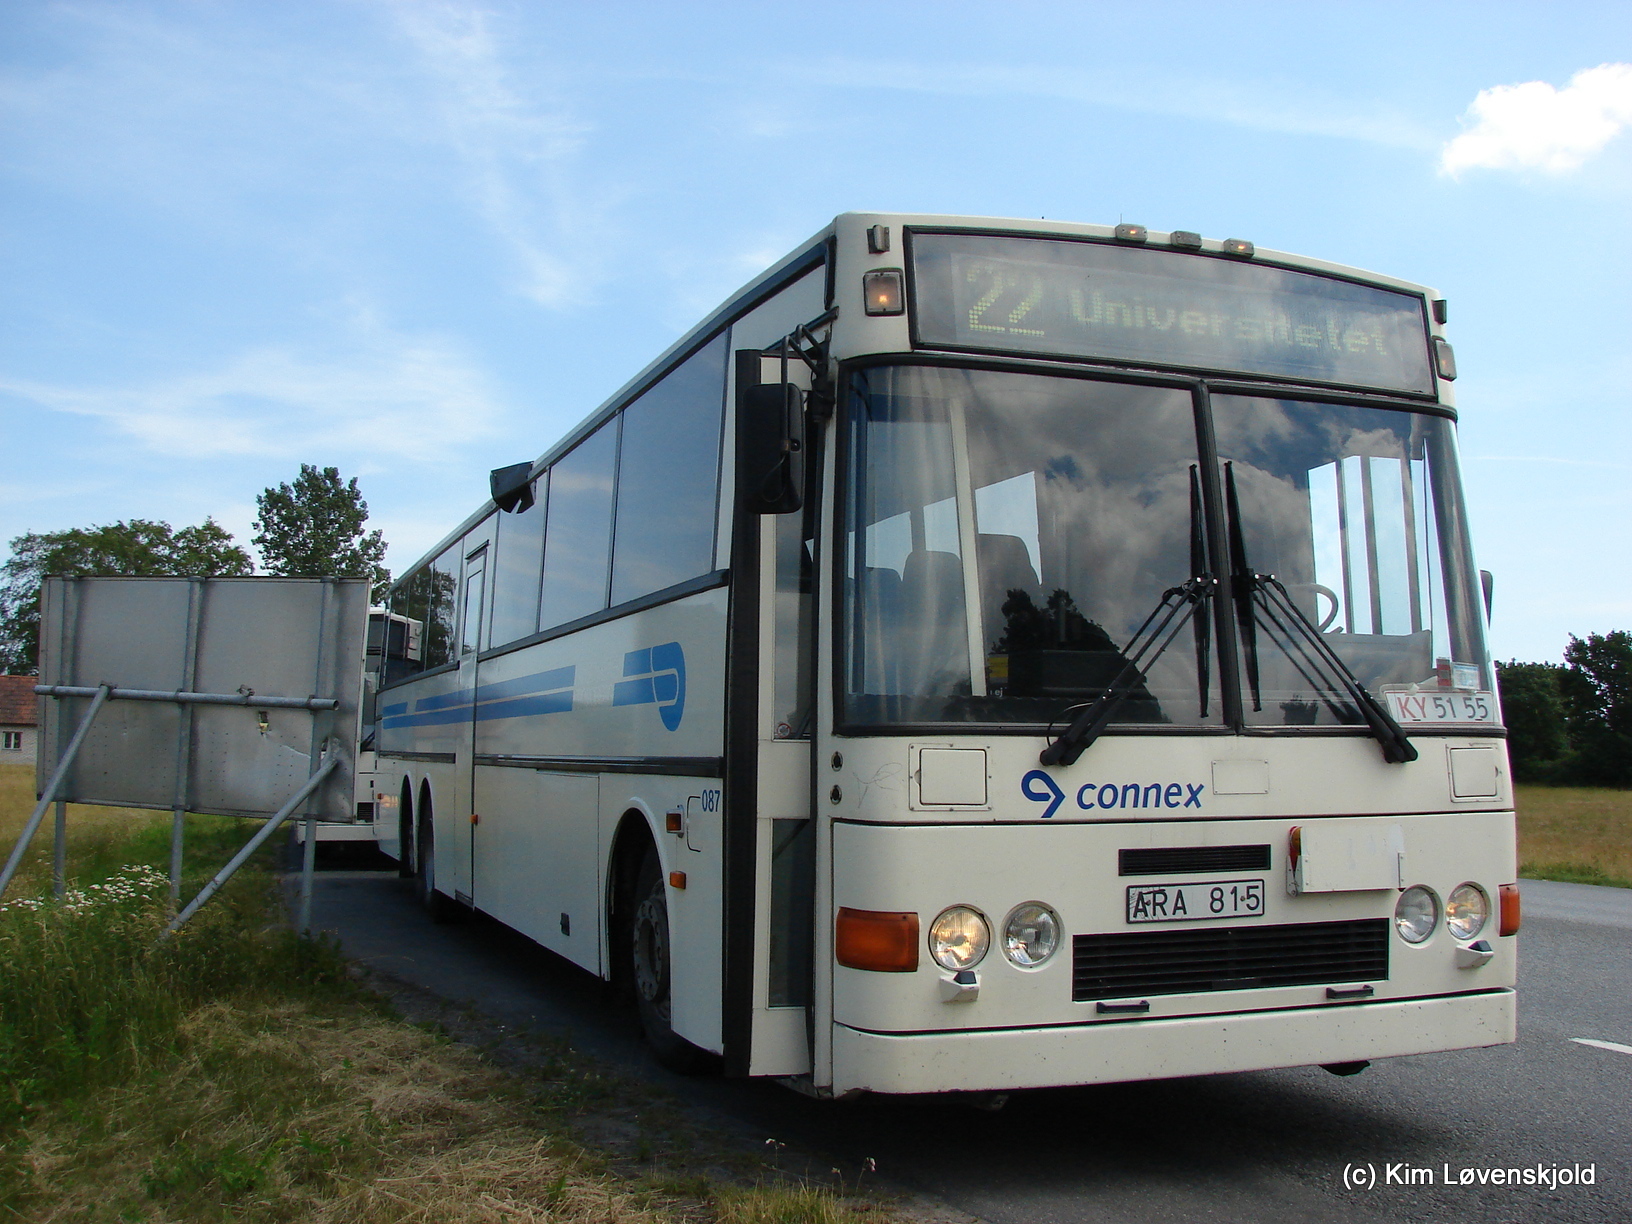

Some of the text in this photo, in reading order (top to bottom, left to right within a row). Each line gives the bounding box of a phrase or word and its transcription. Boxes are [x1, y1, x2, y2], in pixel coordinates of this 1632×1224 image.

[966, 264, 1045, 336] 22
[1397, 696, 1489, 719] KY 51 55
[702, 789, 721, 812] 087
[1076, 782, 1204, 810] connex
[1132, 885, 1261, 919] ARA 815
